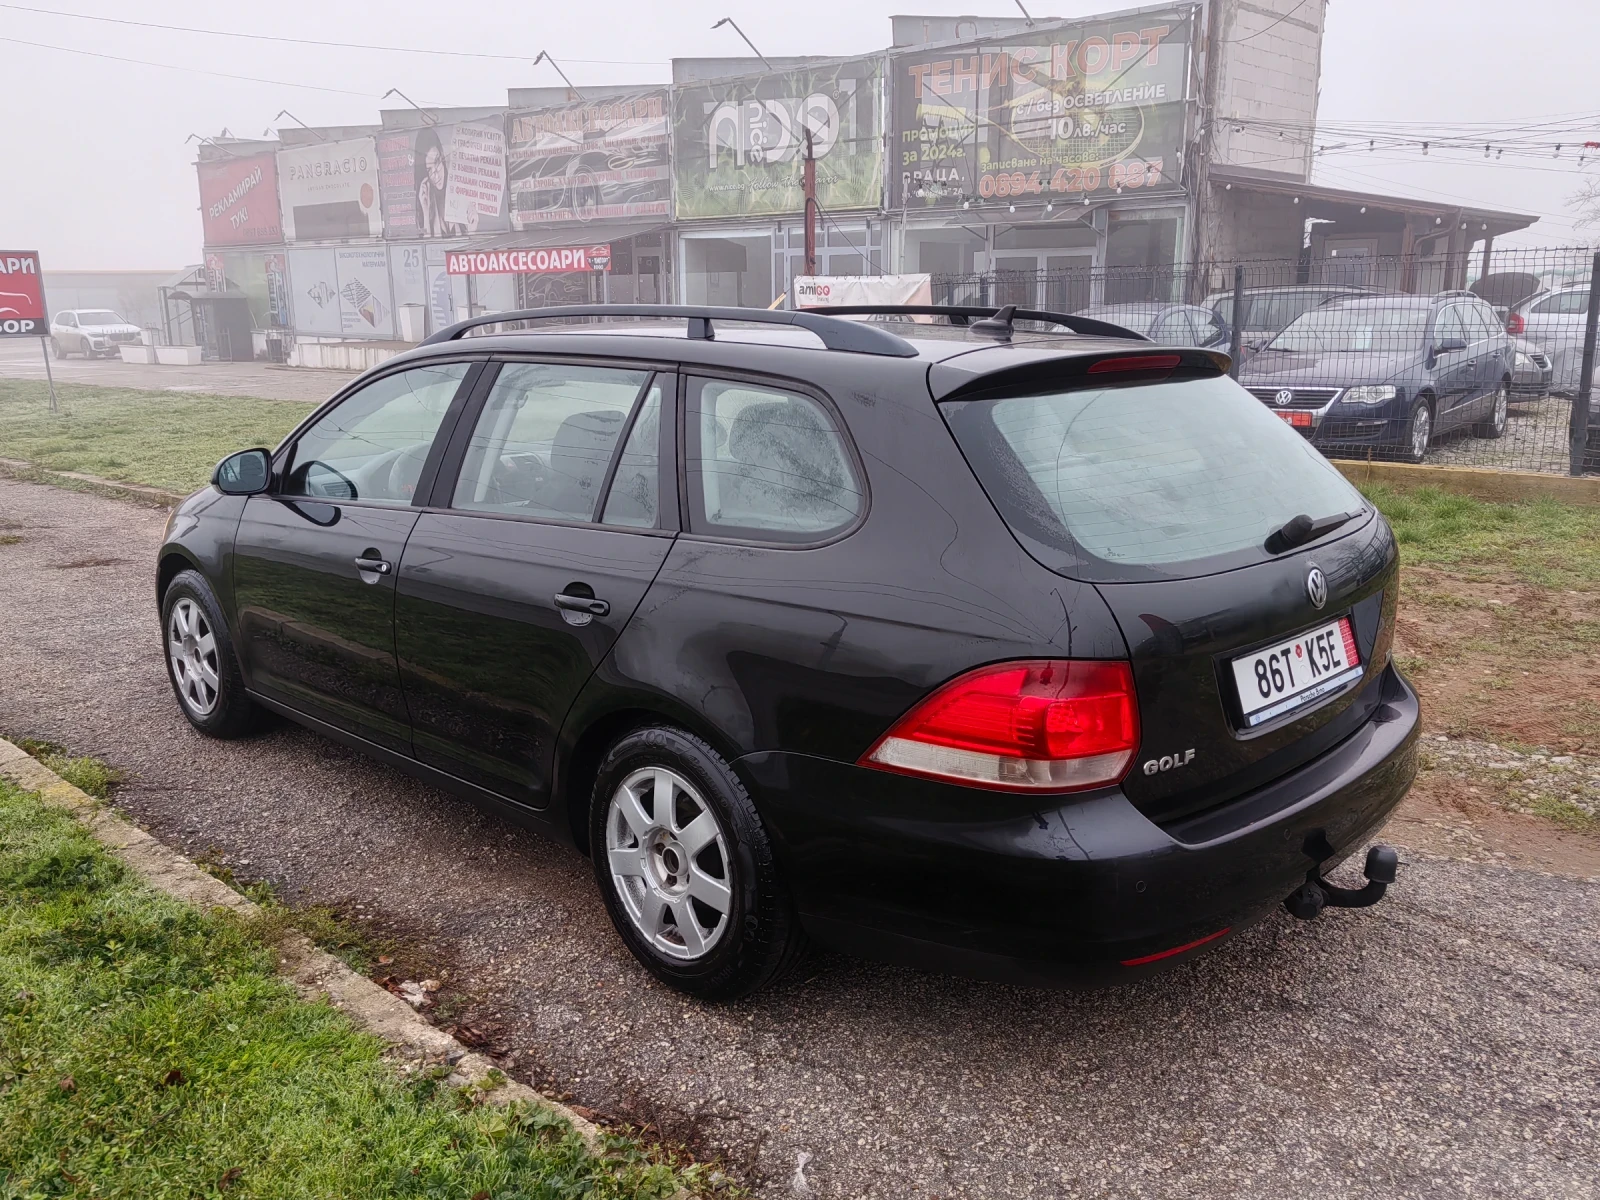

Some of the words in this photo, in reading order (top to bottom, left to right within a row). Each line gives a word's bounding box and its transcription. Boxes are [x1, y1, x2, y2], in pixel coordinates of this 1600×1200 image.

[909, 47, 1037, 99] ТЕНИС
[1049, 25, 1170, 80] КОРТ
[1037, 97, 1060, 114] без
[1064, 84, 1166, 110] ОСВЕТЛЕНИЕ
[511, 96, 663, 144] АВТОАКСЕСОАРИ
[289, 156, 368, 181] PANCRACIO
[979, 170, 1043, 199] 0894
[1049, 166, 1101, 193] 420
[1107, 156, 1164, 190] 887
[209, 165, 262, 221] РЕКЛАМИРАЙ
[230, 205, 248, 229] ТУК!
[403, 248, 420, 268] 25
[449, 248, 586, 273] АВТОАКСЕСОАРИ
[1254, 646, 1295, 700] 86T
[1304, 629, 1342, 679] K5E
[1143, 748, 1196, 776] GOLF
